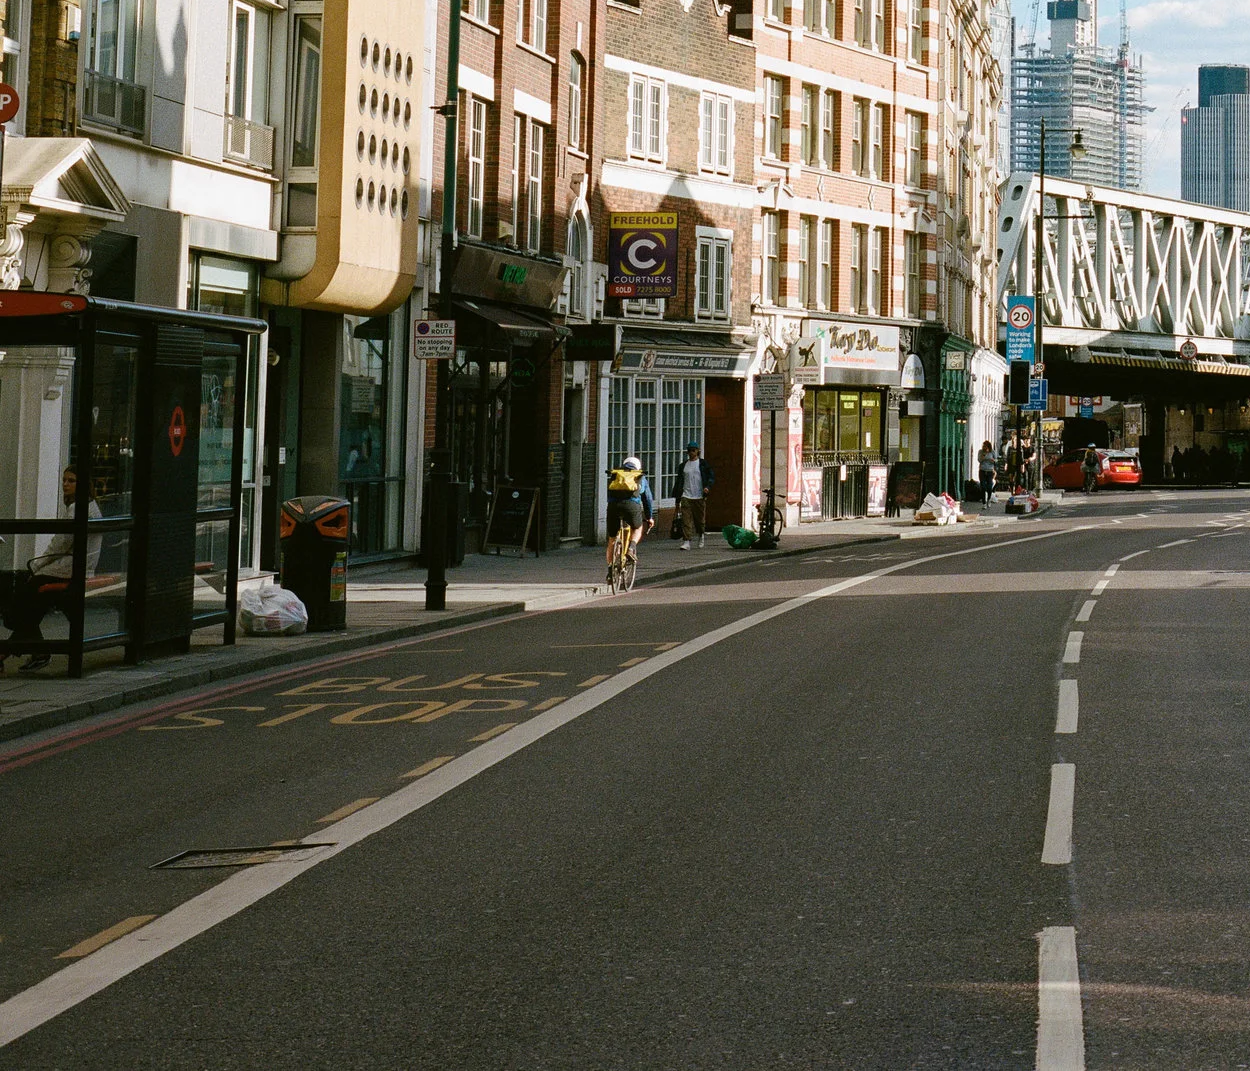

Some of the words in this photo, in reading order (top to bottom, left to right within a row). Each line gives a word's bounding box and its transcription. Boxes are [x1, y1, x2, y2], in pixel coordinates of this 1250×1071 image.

[613, 216, 674, 225] FREEHOLD
[627, 238, 657, 269] C
[613, 276, 672, 284] COURTNEYS
[615, 286, 632, 294] SOLD
[1013, 312, 1029, 322] 20
[274, 672, 567, 696] BUS
[138, 698, 529, 730] STOP
